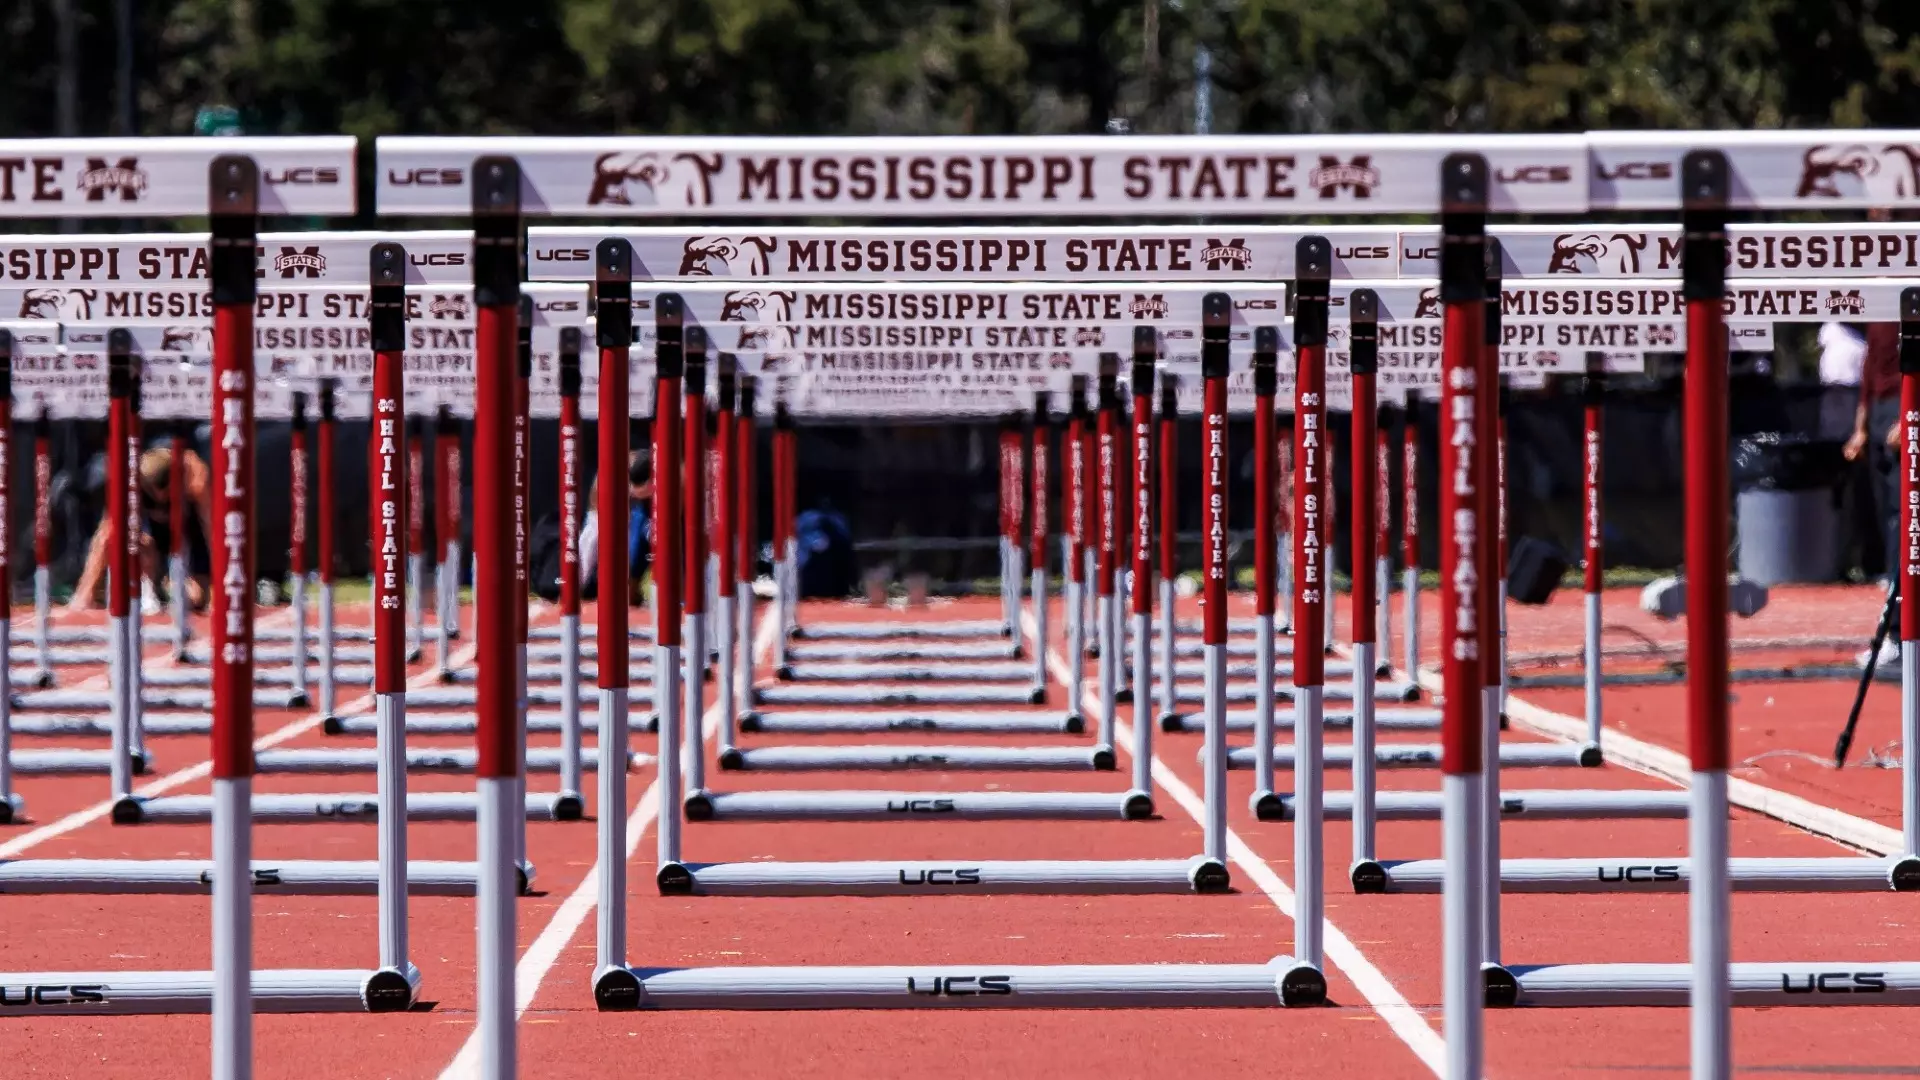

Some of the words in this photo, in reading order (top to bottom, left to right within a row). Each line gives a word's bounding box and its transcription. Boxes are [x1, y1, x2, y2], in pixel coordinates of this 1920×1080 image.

[264, 167, 340, 184] UCS
[388, 168, 465, 186] UCS
[737, 157, 1096, 200] MISSISSIPPI
[1123, 156, 1297, 200] STATE
[1495, 165, 1571, 184] UCS
[410, 253, 465, 266] UCS
[535, 248, 591, 261] UCS
[787, 240, 1047, 272] MISSISSIPPI
[1065, 239, 1192, 272] STATE
[1335, 246, 1390, 259] UCS
[1405, 248, 1441, 259] UC
[1657, 235, 1918, 269] MSISSIPPI
[536, 300, 580, 311] UCS
[804, 293, 1008, 319] MISSISSIPPI
[1022, 293, 1121, 319] STATE
[1233, 299, 1277, 310] UCS
[1501, 290, 1686, 316] MISSISSIPP
[1721, 289, 1818, 315] STATE
[411, 328, 474, 350] STAT
[807, 327, 973, 348] MISSISSIPPI
[985, 326, 1066, 348] STATE
[1557, 325, 1639, 346] STATE
[380, 419, 396, 489] HAIL
[515, 431, 524, 487] HAIL
[1210, 429, 1223, 487] HAIL
[1303, 413, 1318, 484] HAIL
[1907, 426, 1920, 483] HAIL
[515, 495, 525, 565] STATE
[1211, 493, 1223, 564] STATE
[1908, 490, 1920, 560] STATE
[381, 501, 397, 588] STATE
[1304, 494, 1319, 583] STATE
[887, 799, 955, 812] UCS
[899, 868, 981, 885] UCS
[1598, 866, 1681, 882] UCS
[907, 975, 1012, 995] UCS
[1781, 972, 1887, 993] UCS
